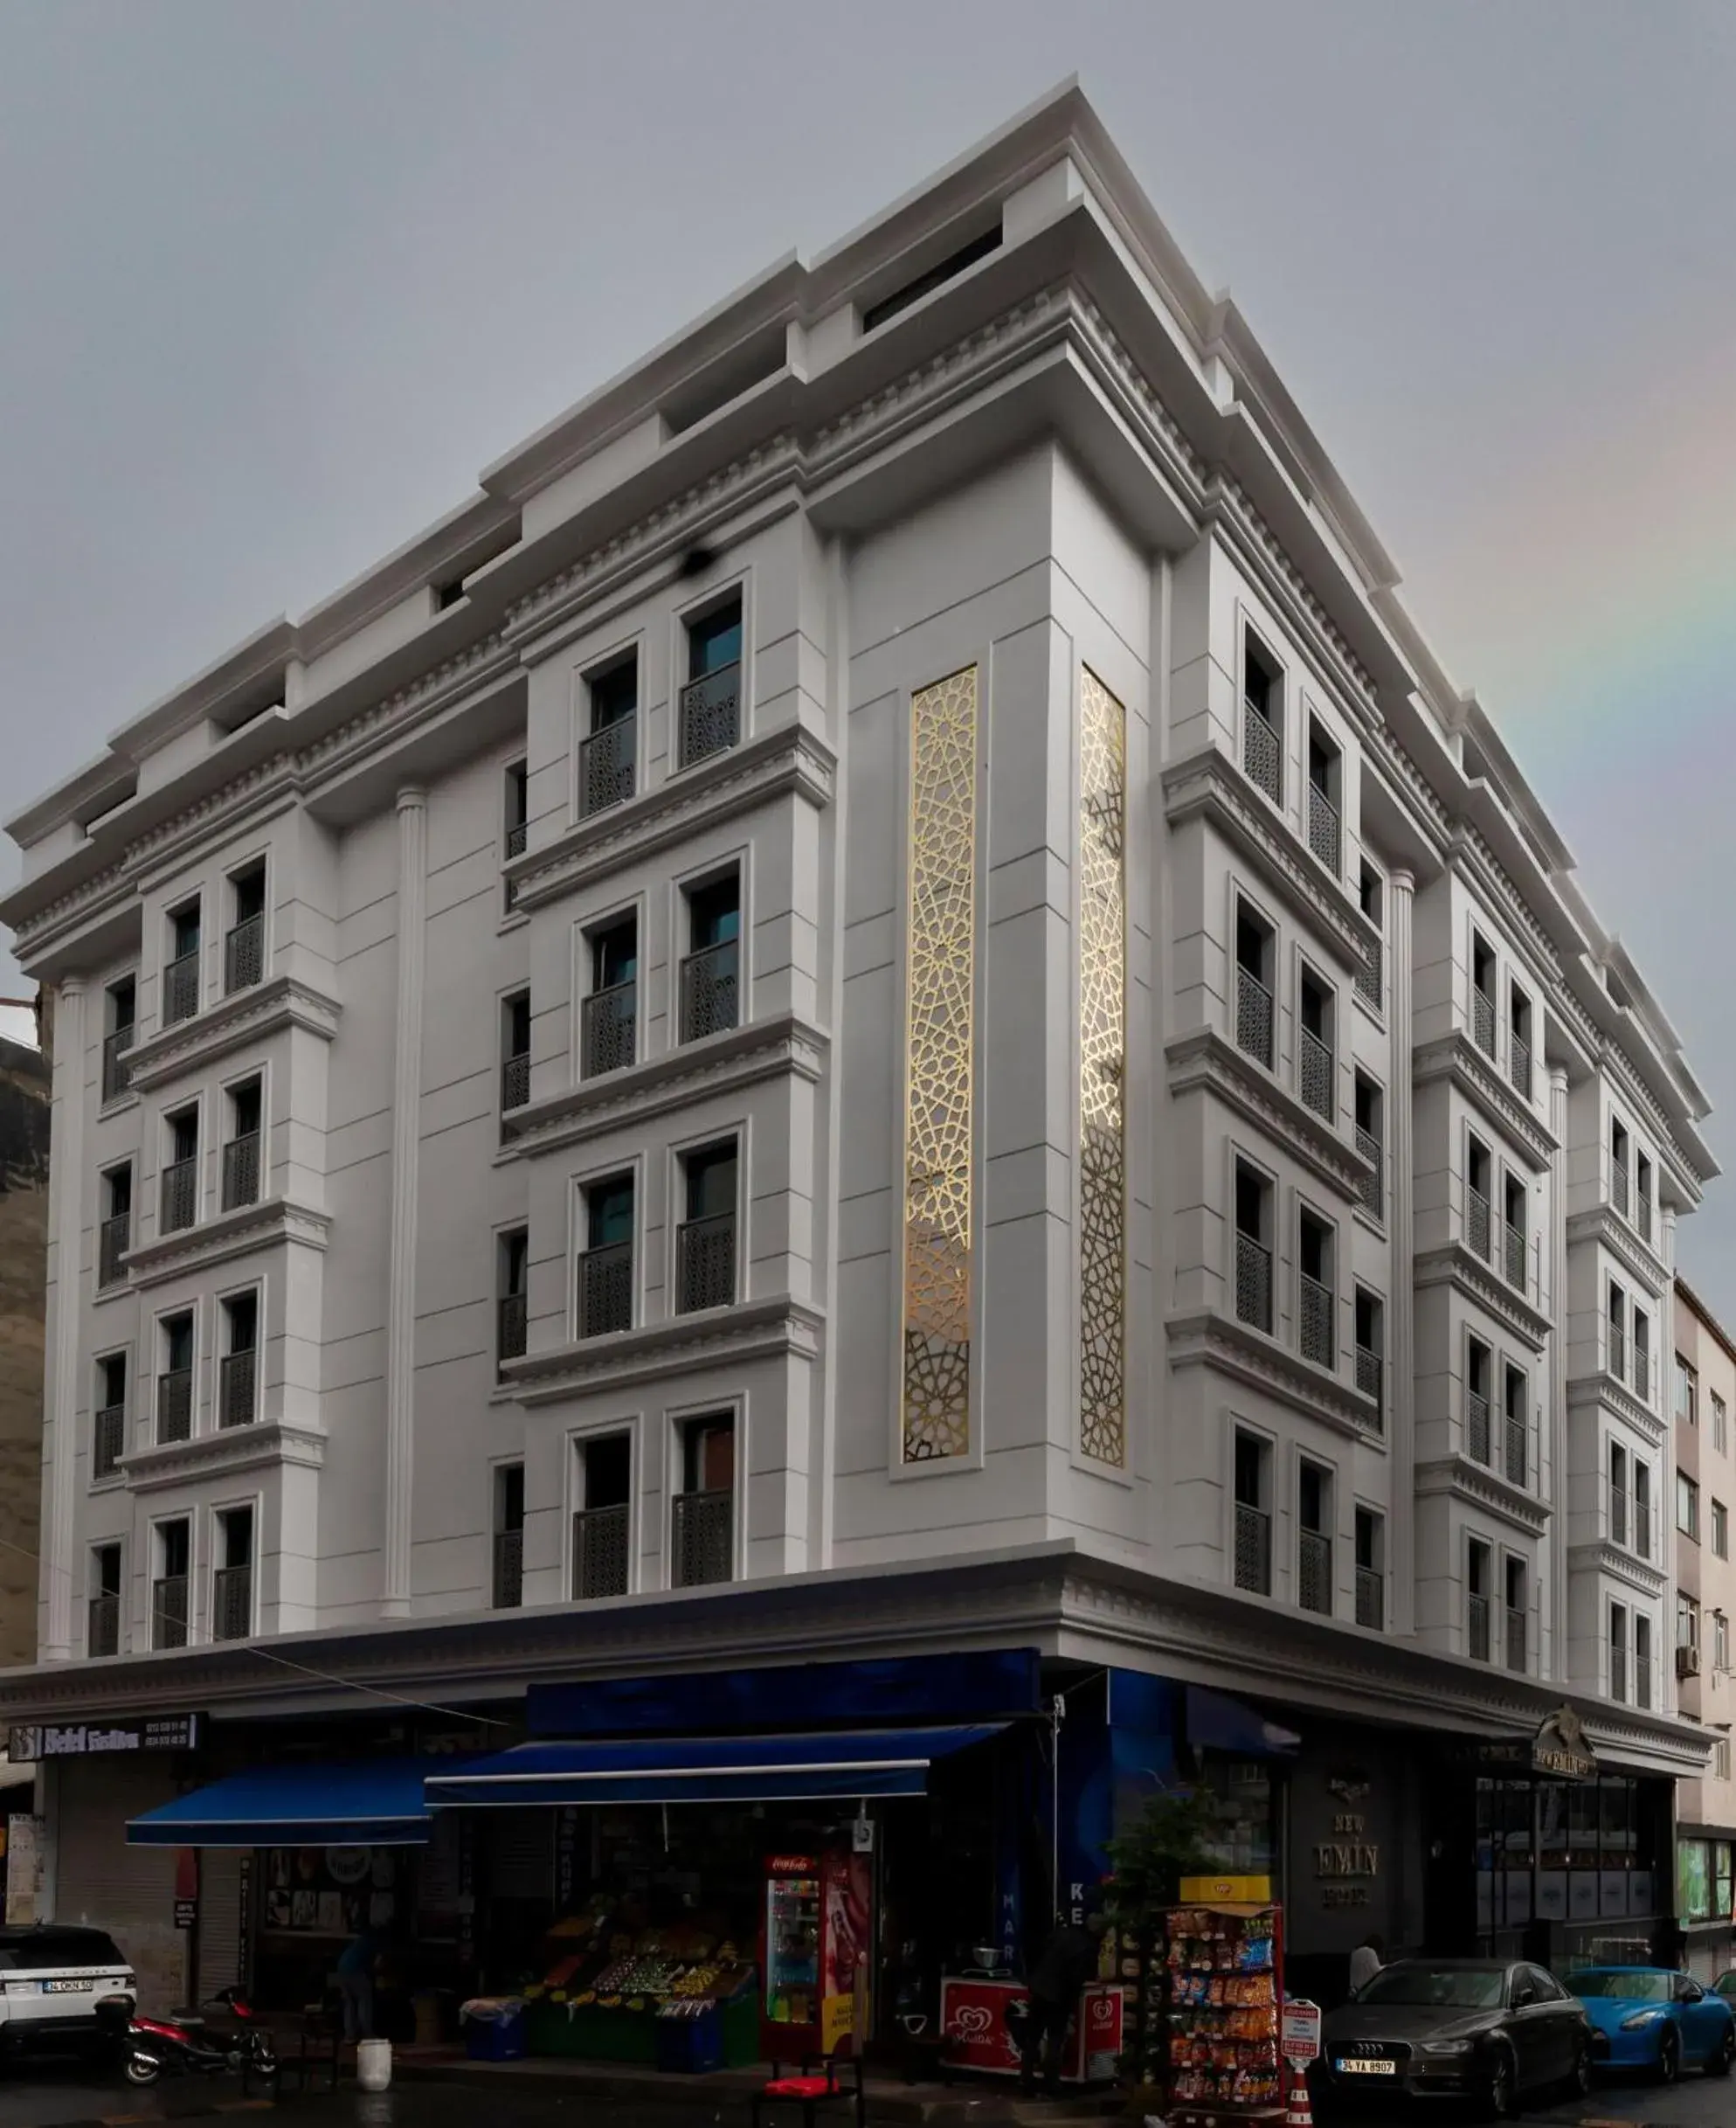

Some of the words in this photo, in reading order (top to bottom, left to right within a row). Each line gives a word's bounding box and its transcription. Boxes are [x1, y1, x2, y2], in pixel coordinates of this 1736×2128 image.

[1334, 1814, 1365, 1833] NEW
[1343, 2060, 1352, 2071] 34
[1356, 2061, 1366, 2071] YA
[1369, 2062, 1393, 2073] 8907
